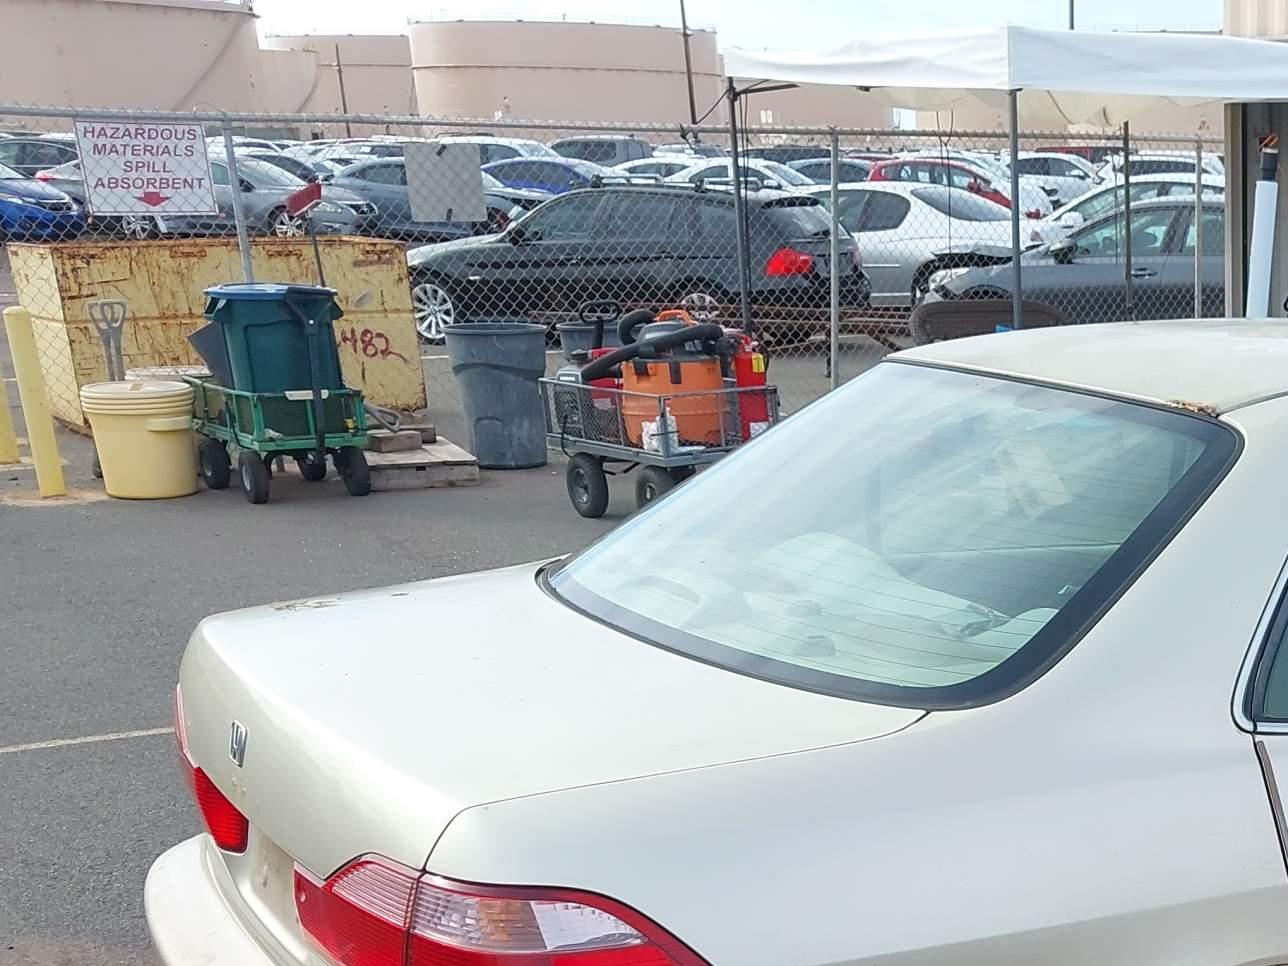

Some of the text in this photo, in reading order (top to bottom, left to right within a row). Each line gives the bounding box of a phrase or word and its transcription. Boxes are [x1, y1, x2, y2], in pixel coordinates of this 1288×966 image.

[83, 126, 197, 140] HAZARDOUS
[92, 143, 195, 157] MATERIALS
[122, 160, 173, 173] SPILL
[94, 177, 205, 190] ABSORBENT
